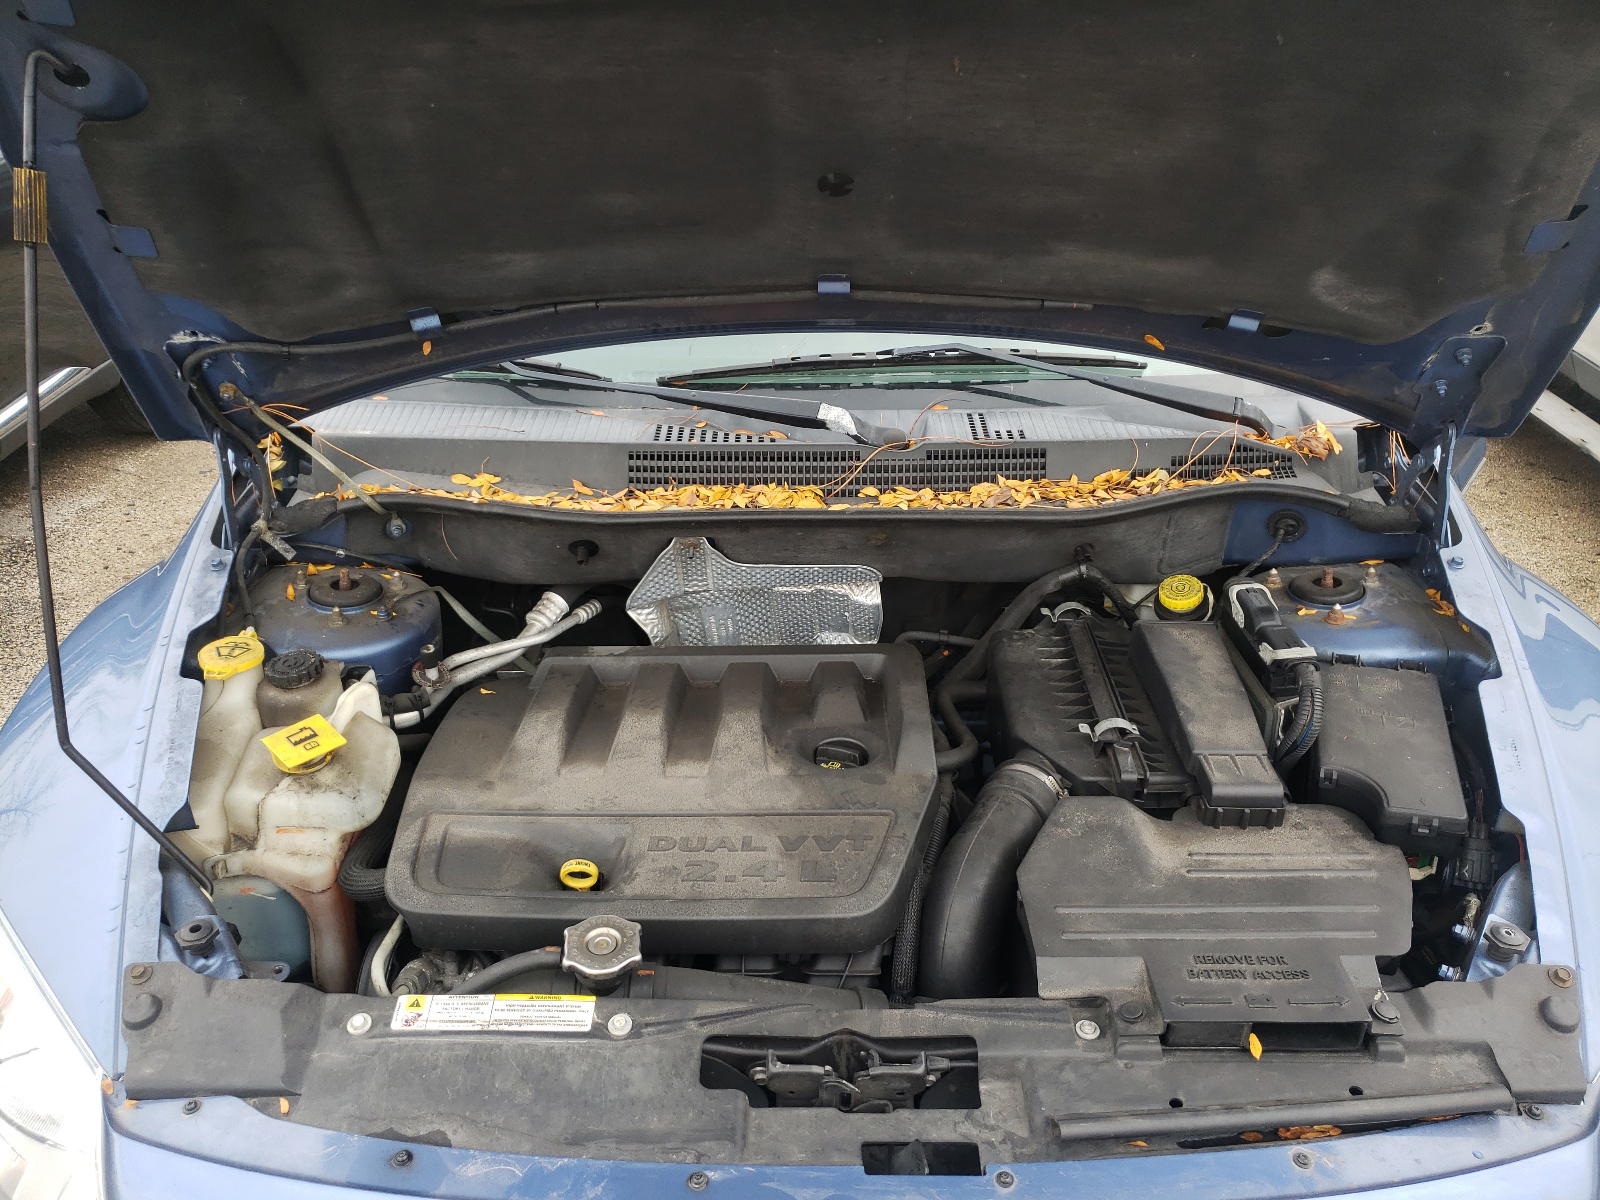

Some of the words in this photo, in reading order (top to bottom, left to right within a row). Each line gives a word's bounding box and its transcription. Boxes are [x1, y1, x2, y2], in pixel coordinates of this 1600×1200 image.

[646, 835, 770, 852] DUAL
[777, 835, 874, 852] VVT
[1192, 954, 1256, 966] REMOVE
[1257, 954, 1289, 966] FOR
[1186, 968, 1248, 980] BATTERY
[1252, 969, 1311, 980] ACCESS
